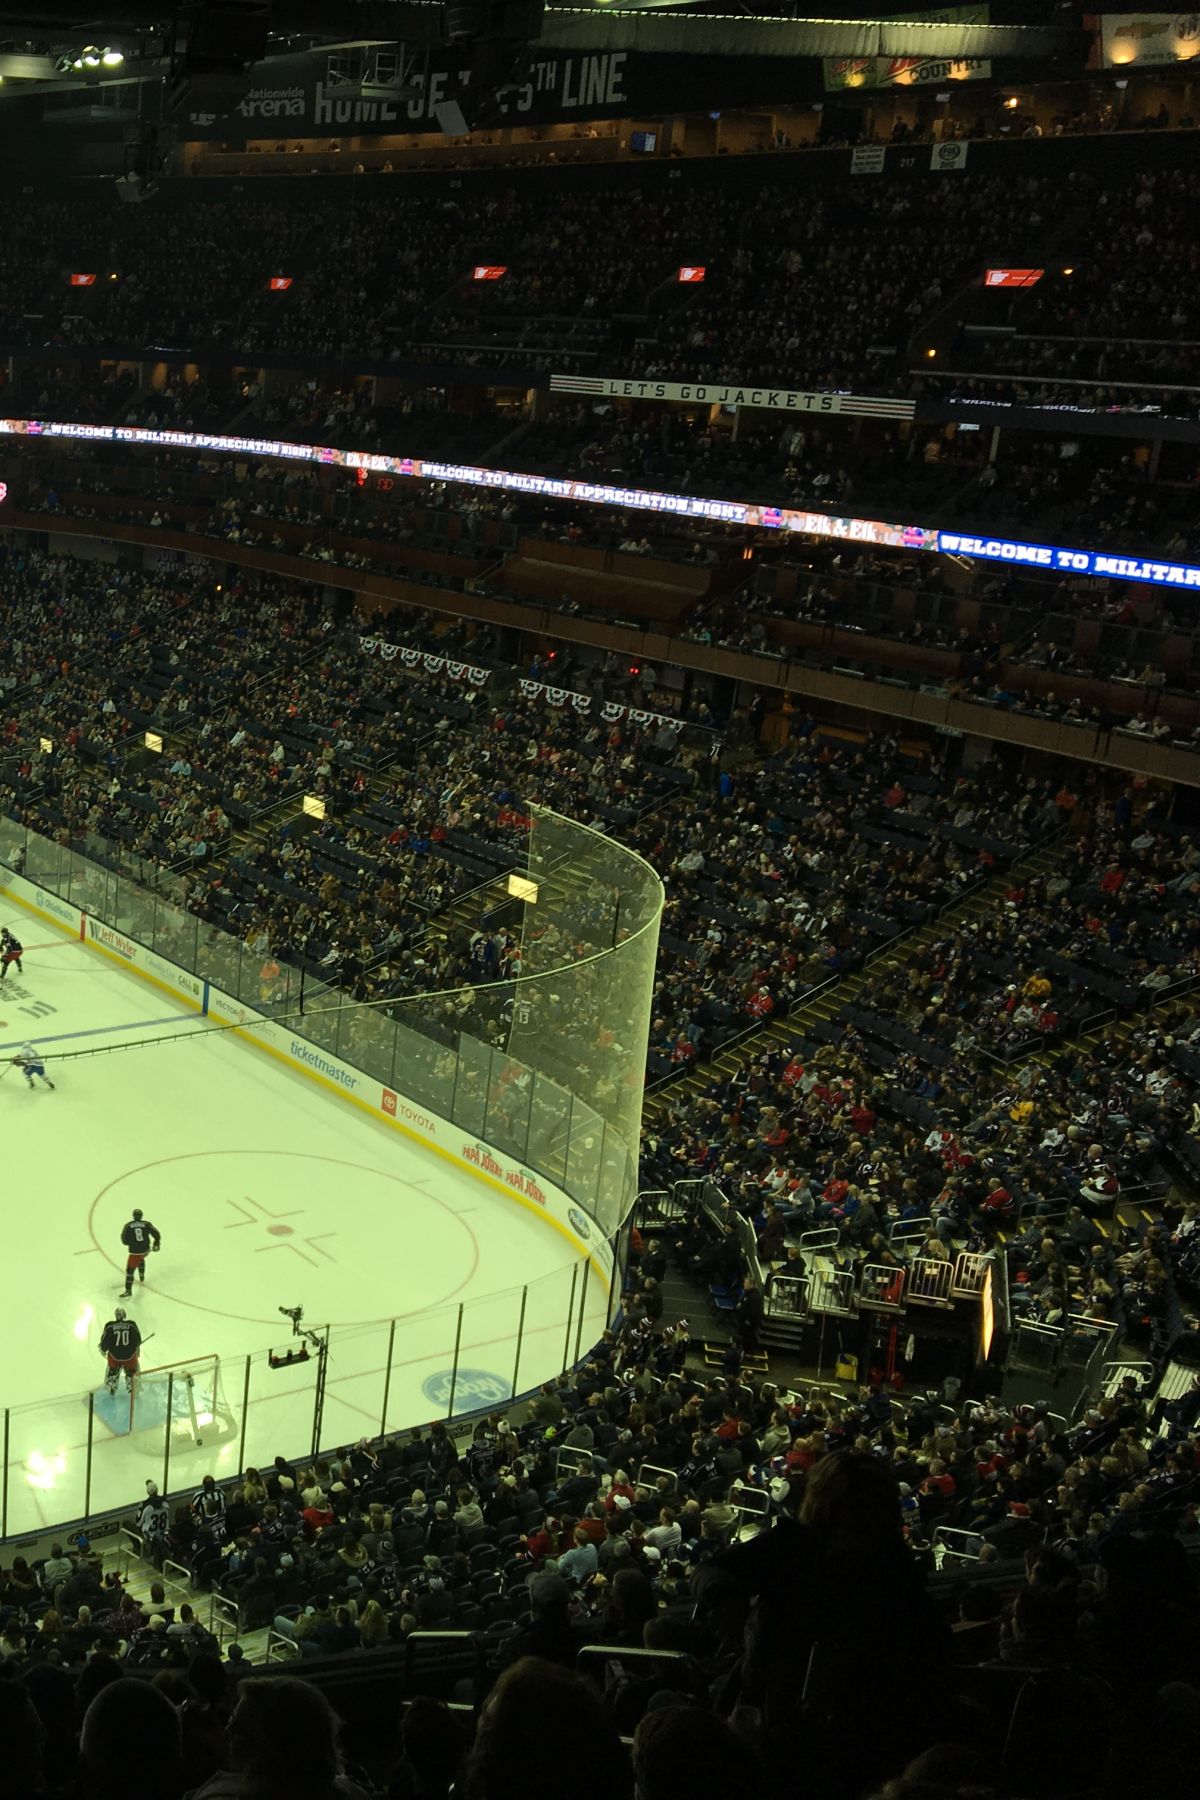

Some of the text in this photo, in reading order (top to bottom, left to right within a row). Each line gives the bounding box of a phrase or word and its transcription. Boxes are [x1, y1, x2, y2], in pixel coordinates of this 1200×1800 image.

[561, 52, 627, 108] LINE
[609, 382, 833, 410] LET'S GO JACKETS
[51, 425, 313, 458] WELCOME TO MILITARY APPRECIATION NIGHT
[422, 463, 745, 519] WELCOME TO MILITARY APPRECIATION NIGHT
[803, 514, 877, 542] Elk & Elk
[941, 534, 1053, 565] WELCOME
[1056, 551, 1089, 569] TO
[101, 928, 137, 957] Jeff Wyler
[290, 1041, 357, 1089] ticketmaster
[400, 1104, 436, 1134] TOYOTA
[463, 1146, 480, 1165] PAPA
[506, 1171, 523, 1191] PAPA
[134, 1227, 144, 1242] 8
[113, 1331, 130, 1347] 70
